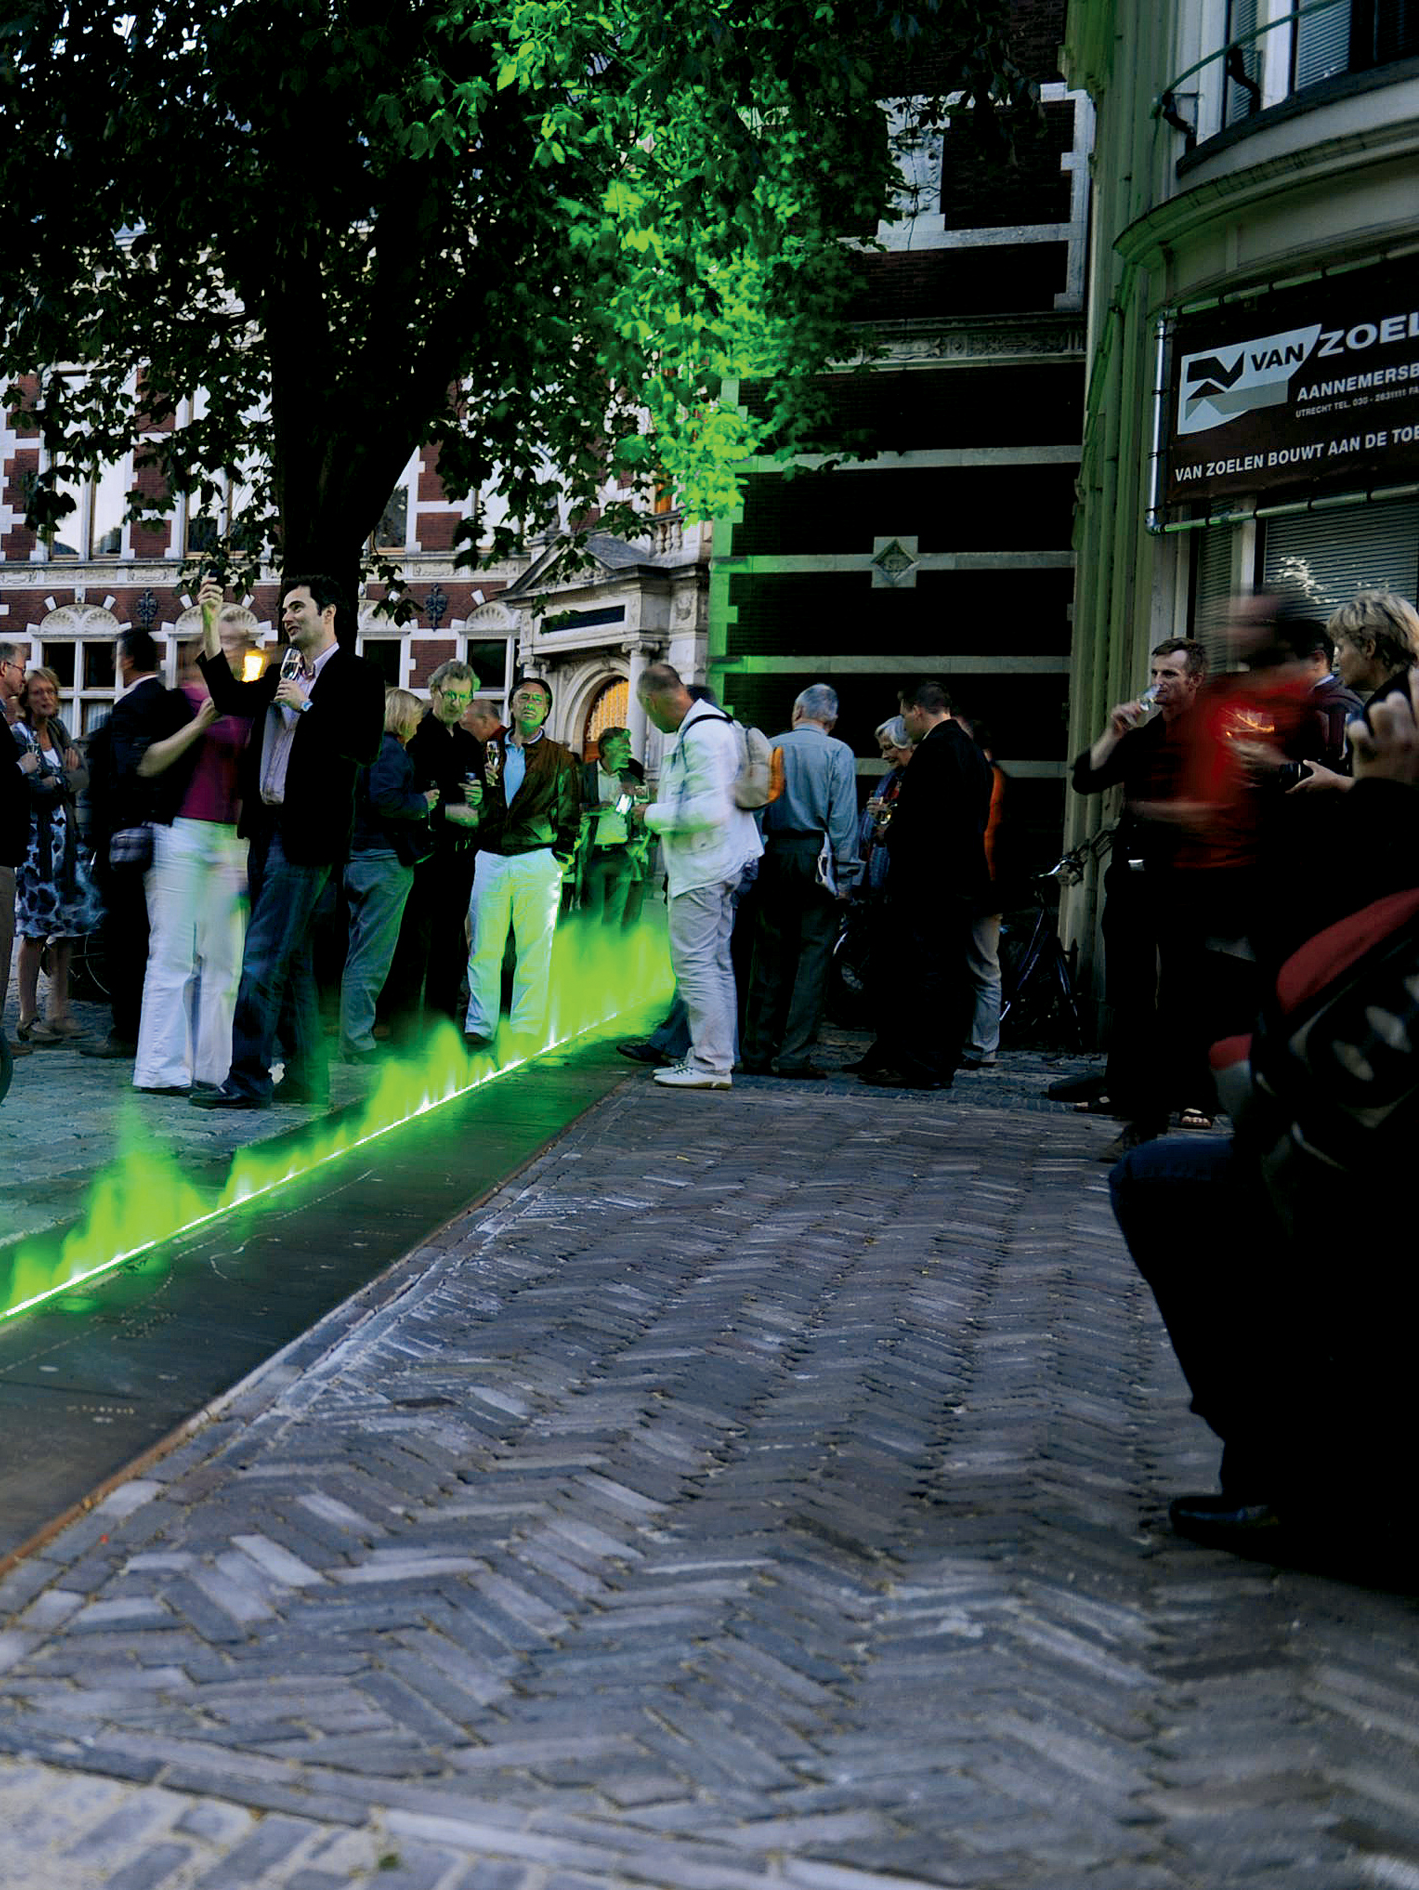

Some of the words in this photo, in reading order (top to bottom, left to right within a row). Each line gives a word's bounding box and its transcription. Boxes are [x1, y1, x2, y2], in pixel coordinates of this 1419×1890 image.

[1251, 343, 1305, 372] VAN
[1295, 403, 1332, 418] UTRECHT
[1175, 464, 1202, 482] VAN
[1205, 454, 1264, 478] ZOELEN
[1267, 443, 1325, 467] BOUWT
[1327, 435, 1361, 457] AAN
[1364, 430, 1388, 449] DE
